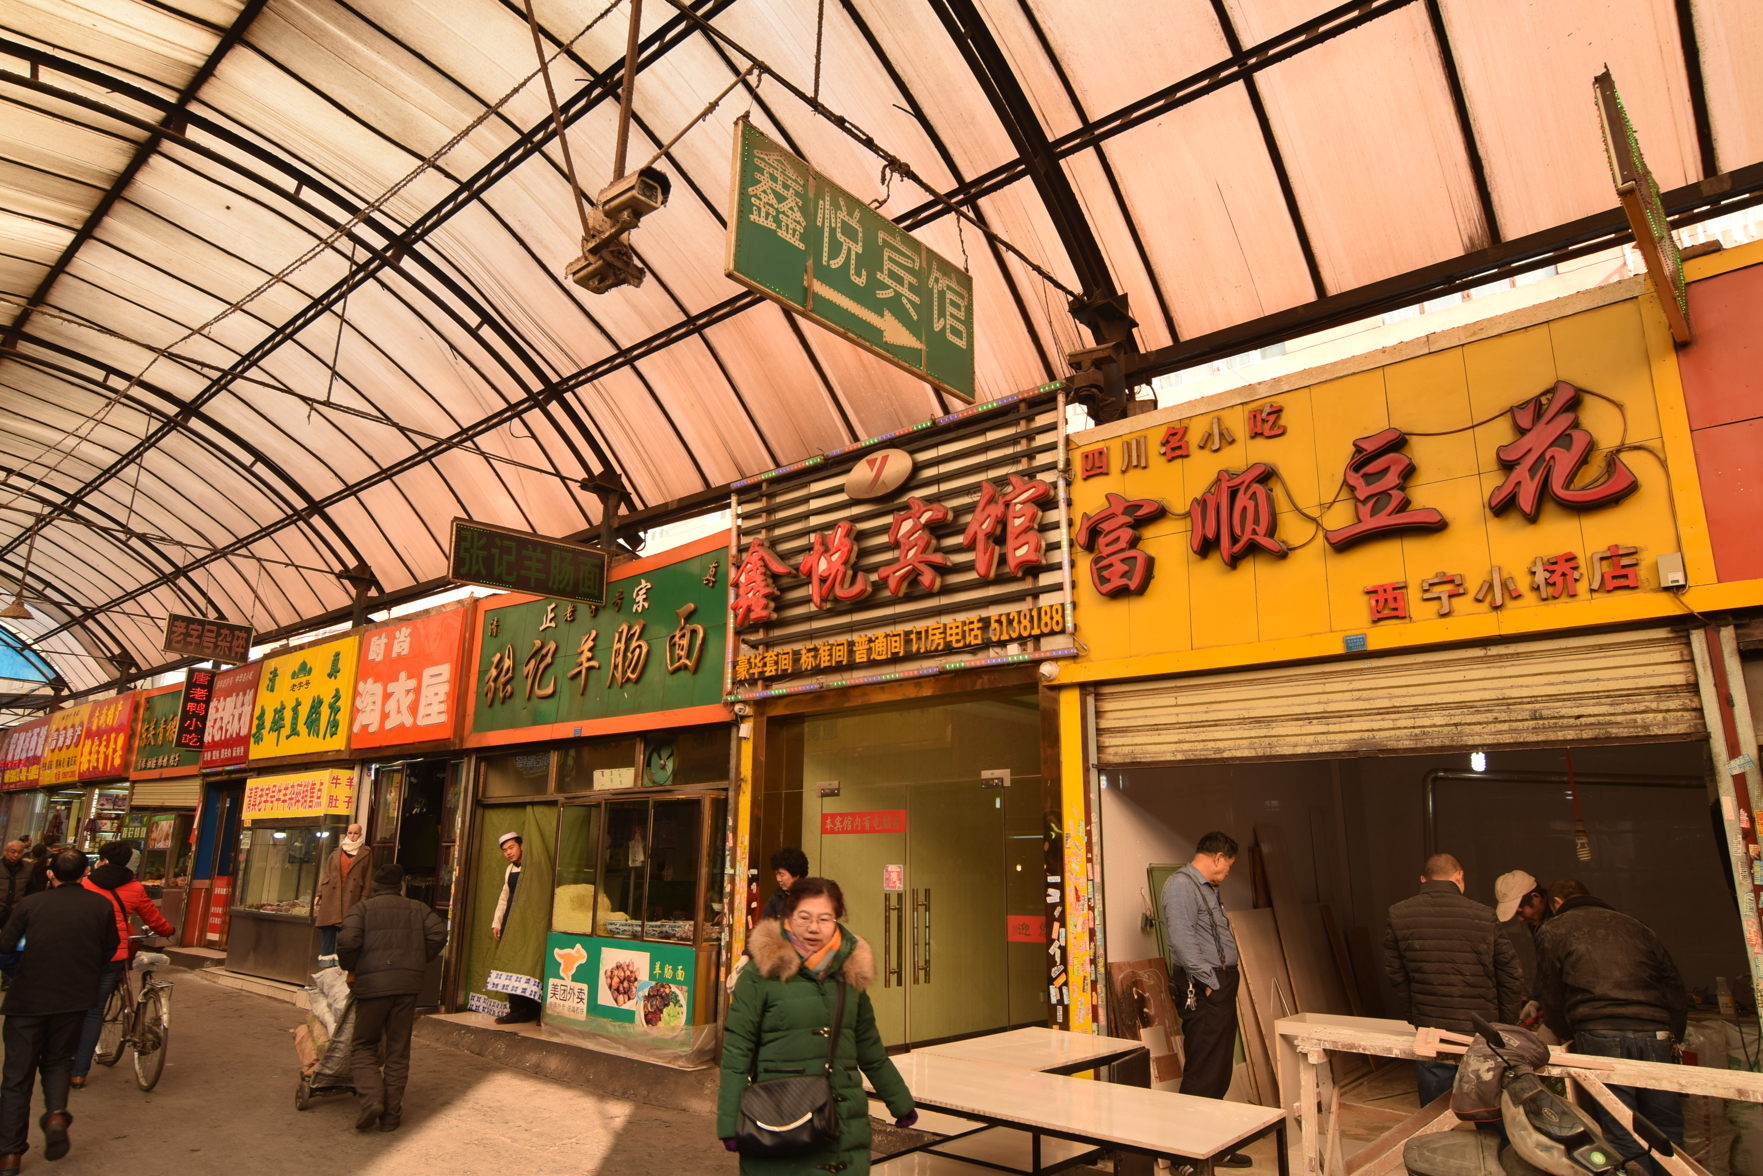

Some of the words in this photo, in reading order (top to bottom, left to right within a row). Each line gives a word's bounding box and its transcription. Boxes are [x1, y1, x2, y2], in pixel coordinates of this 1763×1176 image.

[748, 149, 968, 349] 鑫悦宾馆
[1081, 403, 1286, 480] 四川名小吃
[1076, 380, 1639, 598] 富顺豆花
[459, 529, 600, 597] 张记羊肠面
[702, 560, 719, 588] 真
[730, 474, 1056, 628] 鑫悦宾馆
[1364, 544, 1639, 622] 西宁小桥店
[171, 619, 247, 657] 老字号杂碎
[266, 666, 279, 692] 清
[327, 651, 341, 680] 真
[368, 627, 412, 662] 时尚
[484, 602, 705, 707] 张记羊肠面
[735, 648, 793, 681] 豪华套间
[800, 639, 848, 671] 标准间
[852, 628, 905, 664] 普通间
[909, 615, 983, 654] 订房电话
[989, 603, 1064, 642] 5138188
[182, 671, 211, 747] 唐老鸭小吃
[289, 680, 311, 692] 老字号
[353, 663, 451, 735] 淘衣屋
[245, 779, 324, 813] 清真老字号牛羊杂碎销售点
[550, 983, 585, 1005] 美团外卖
[652, 961, 685, 982] 羊肠面
